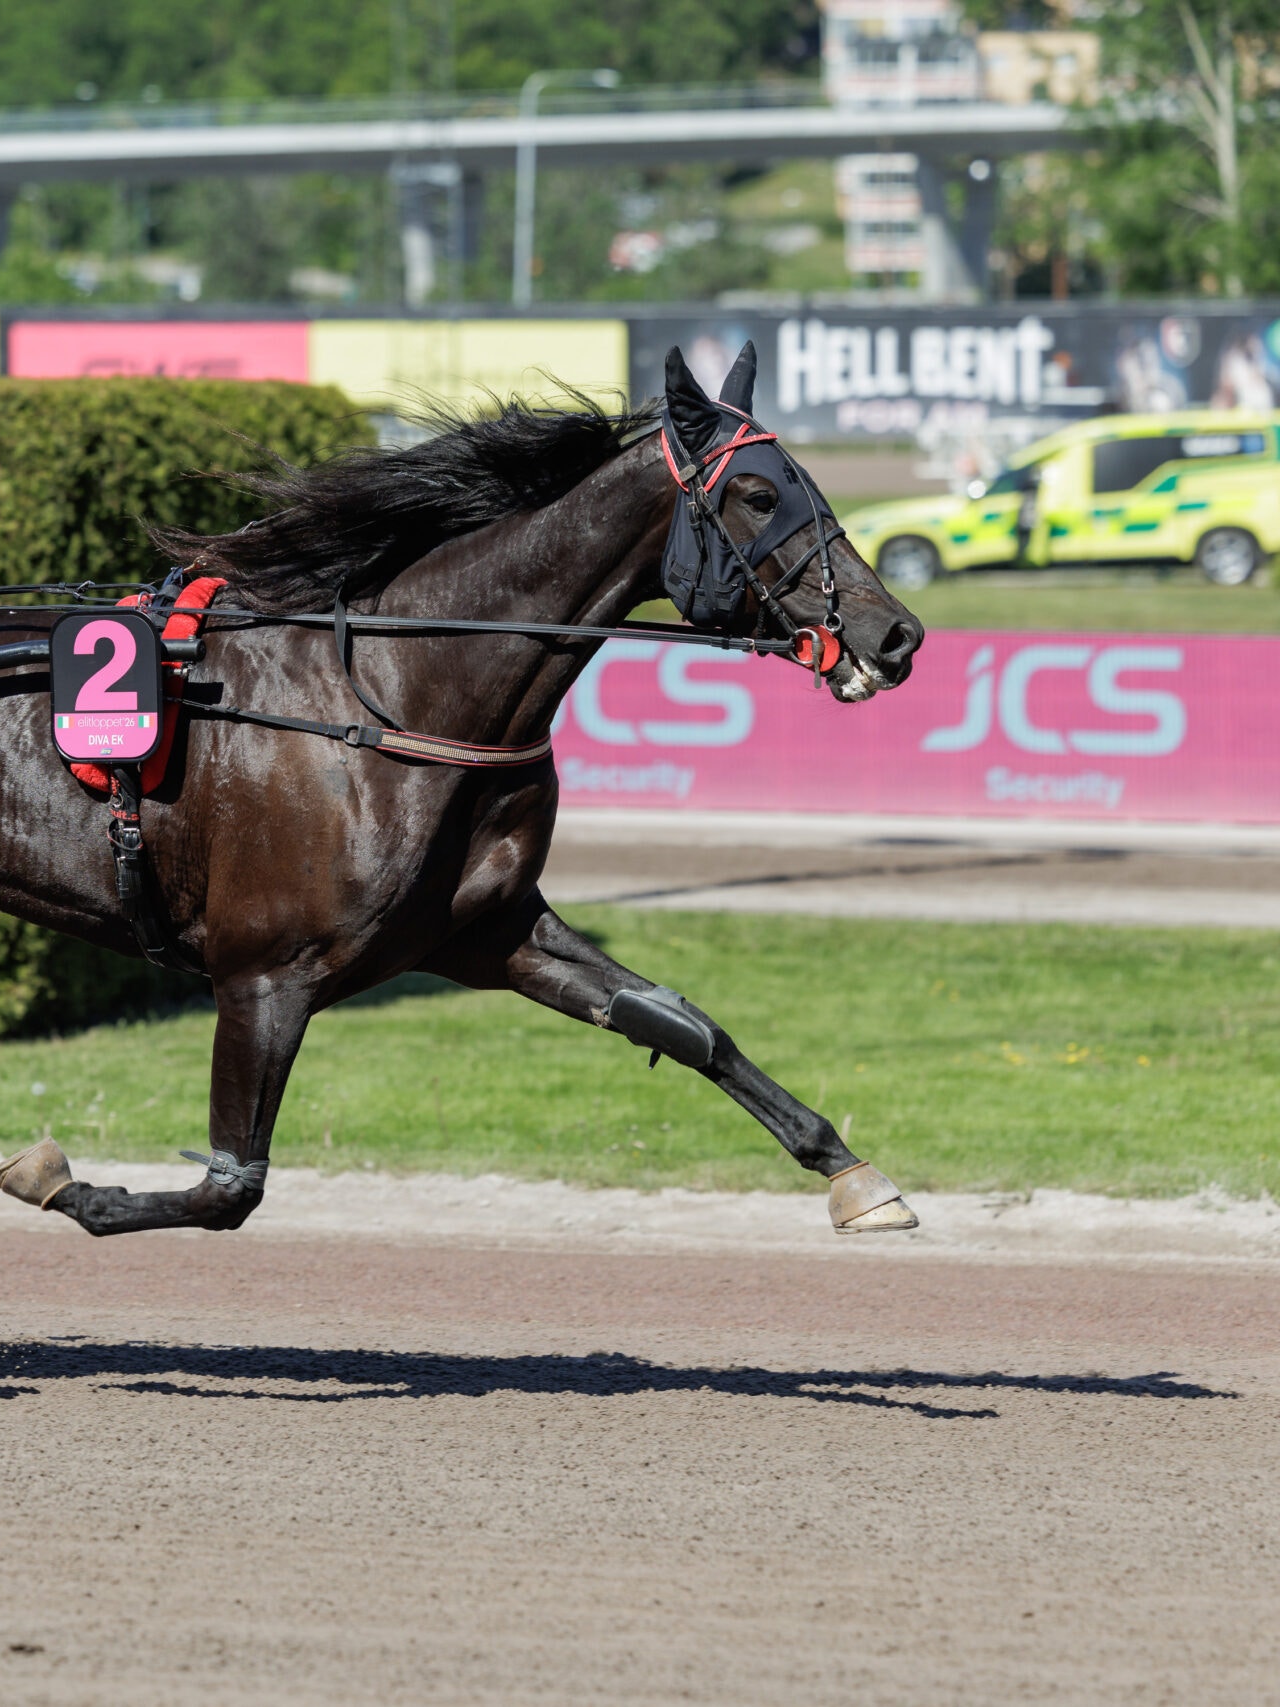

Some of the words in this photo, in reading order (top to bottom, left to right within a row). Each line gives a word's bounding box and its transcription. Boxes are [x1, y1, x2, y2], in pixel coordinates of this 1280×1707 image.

[777, 318, 910, 412] HELL
[912, 315, 1054, 411] BENT
[73, 619, 138, 711] 2
[550, 640, 754, 747] CS
[88, 734, 109, 745] DIVA
[111, 734, 124, 745] EK
[561, 756, 696, 800] Security
[985, 766, 1124, 811] Security
